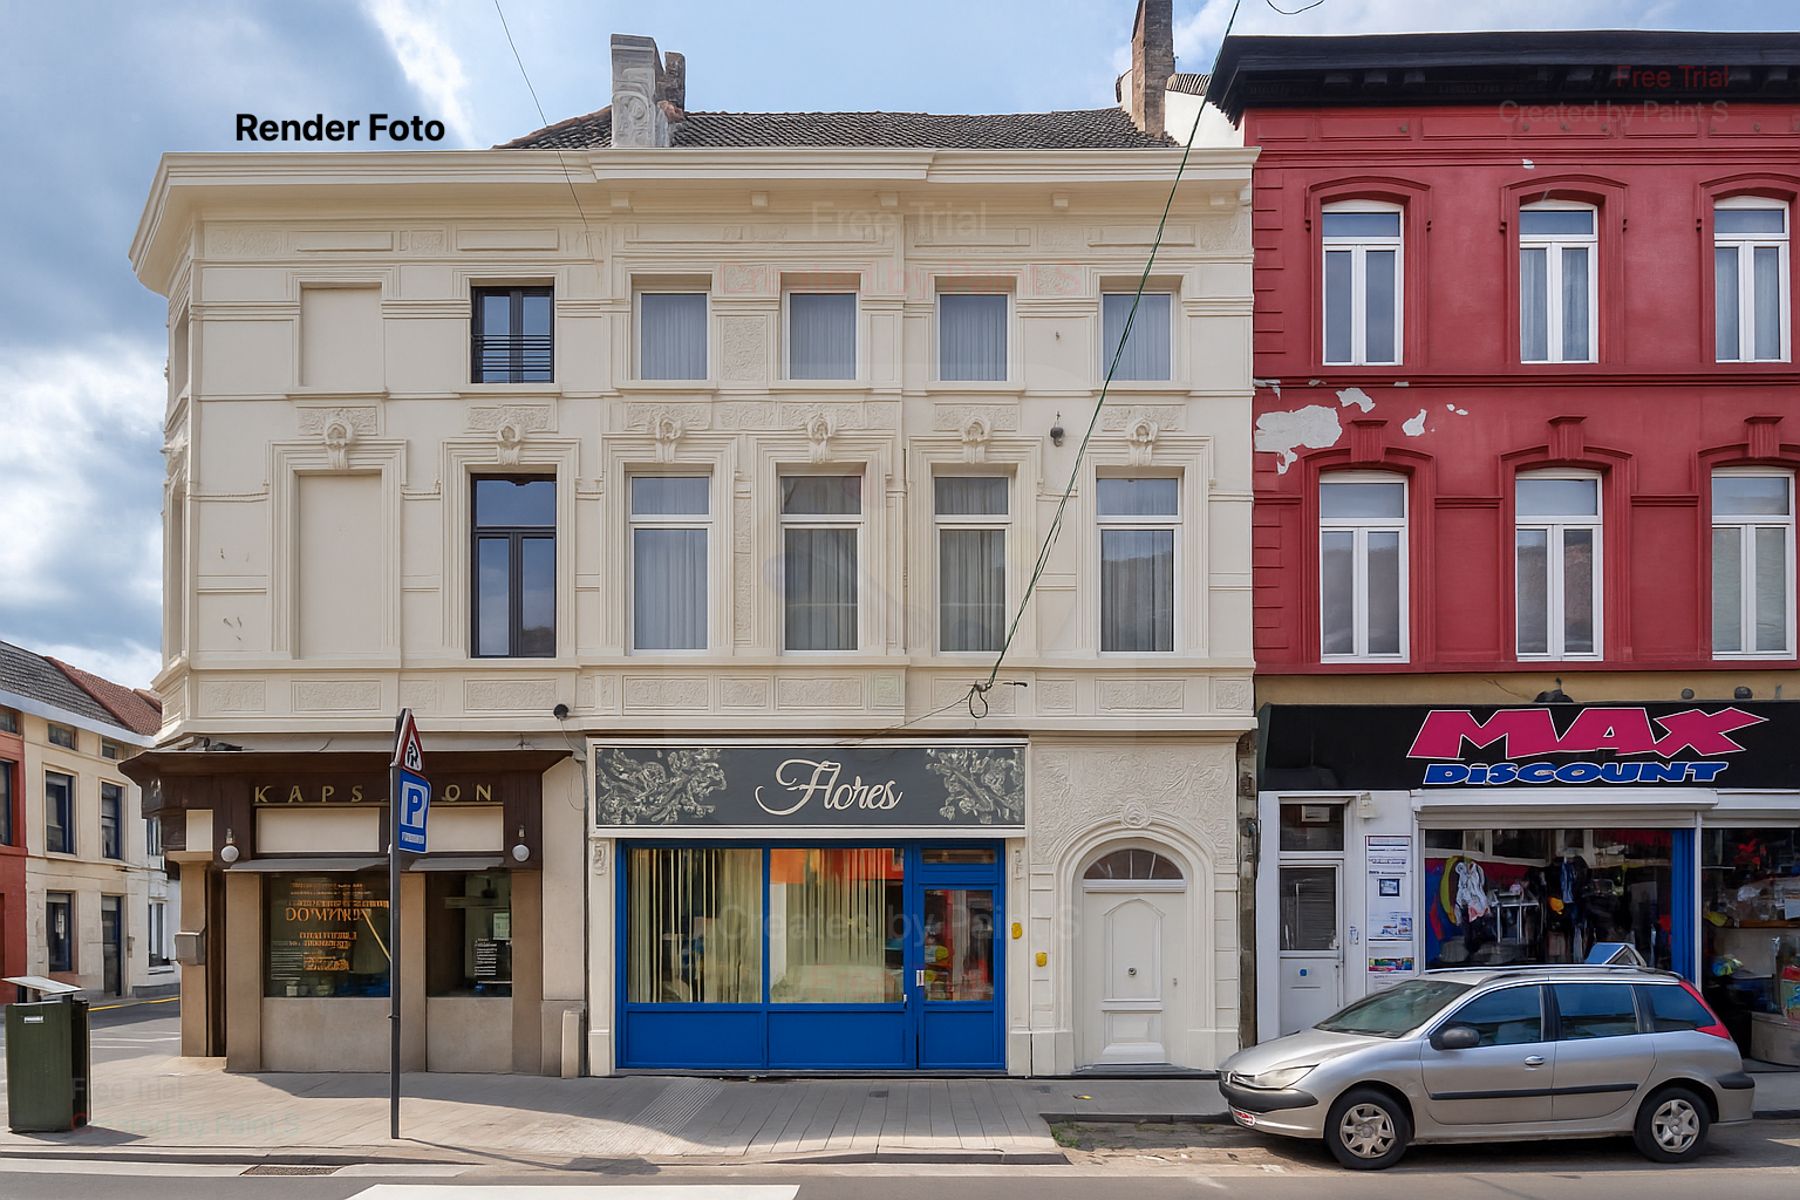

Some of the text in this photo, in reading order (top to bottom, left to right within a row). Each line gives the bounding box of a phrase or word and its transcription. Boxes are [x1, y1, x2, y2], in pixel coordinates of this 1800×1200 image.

[1406, 707, 1770, 760] MAX
[406, 787, 423, 825] P
[755, 758, 903, 815] Flores
